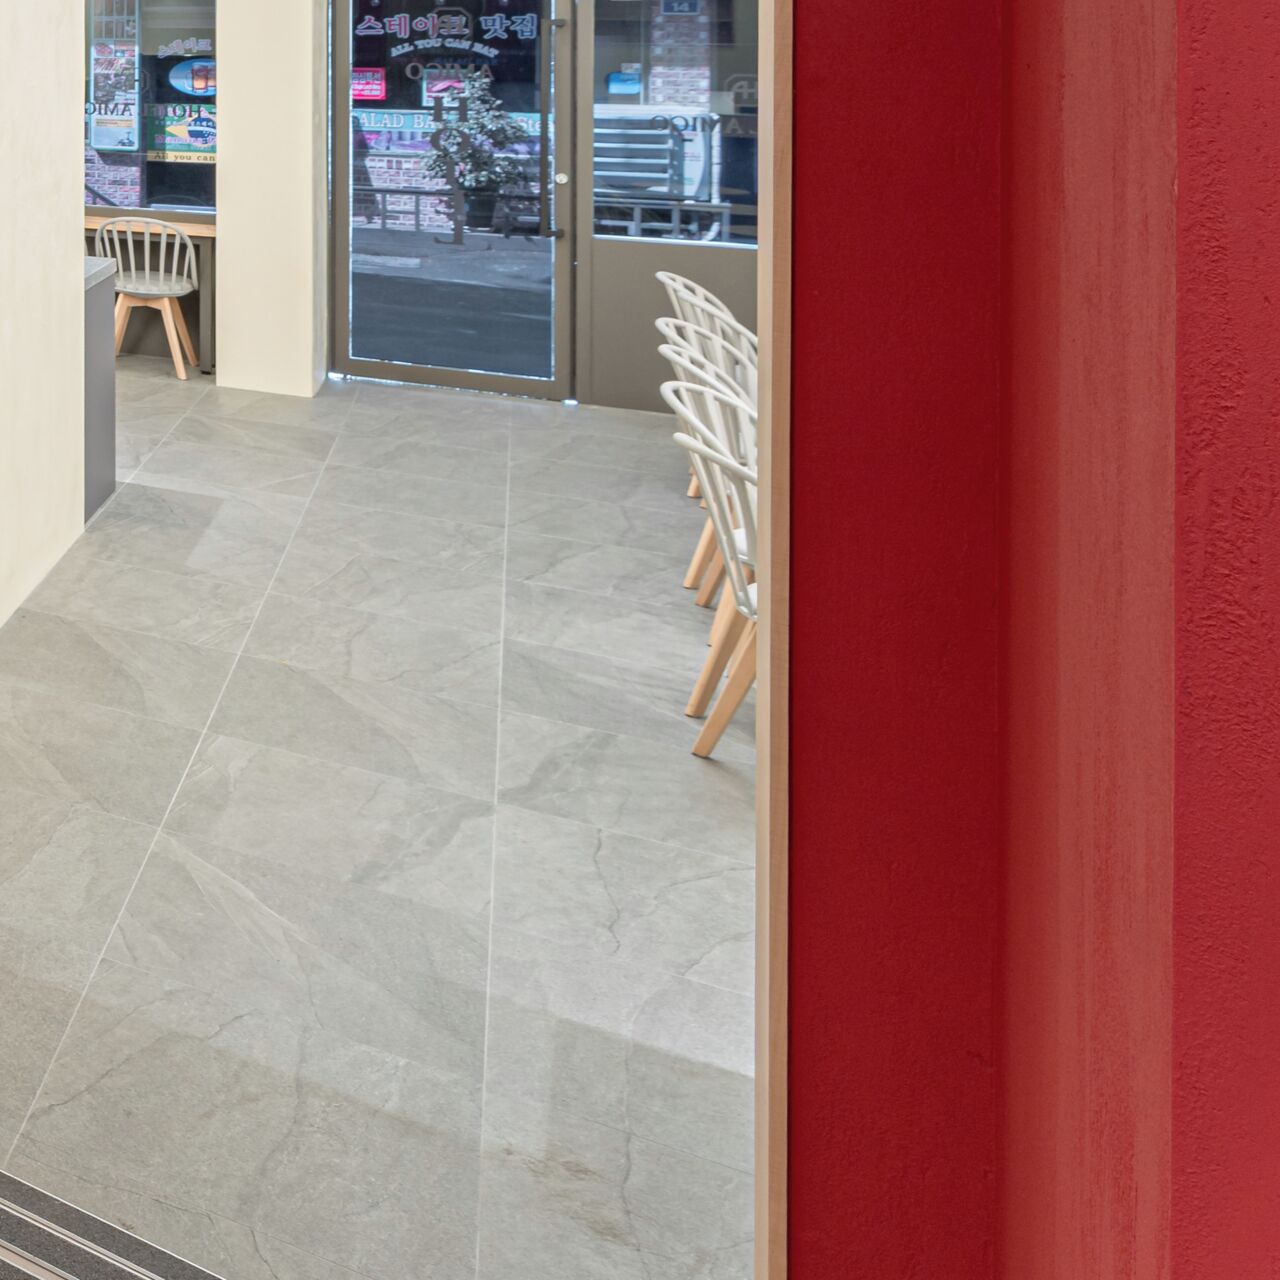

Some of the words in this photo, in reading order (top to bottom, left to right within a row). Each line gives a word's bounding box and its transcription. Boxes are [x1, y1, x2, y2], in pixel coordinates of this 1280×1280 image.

[355, 13, 470, 38] 스테이크
[480, 13, 539, 39] 맛집
[391, 42, 414, 57] ALL
[416, 39, 442, 50] YOU
[444, 38, 470, 50] CAN
[174, 154, 192, 162] you
